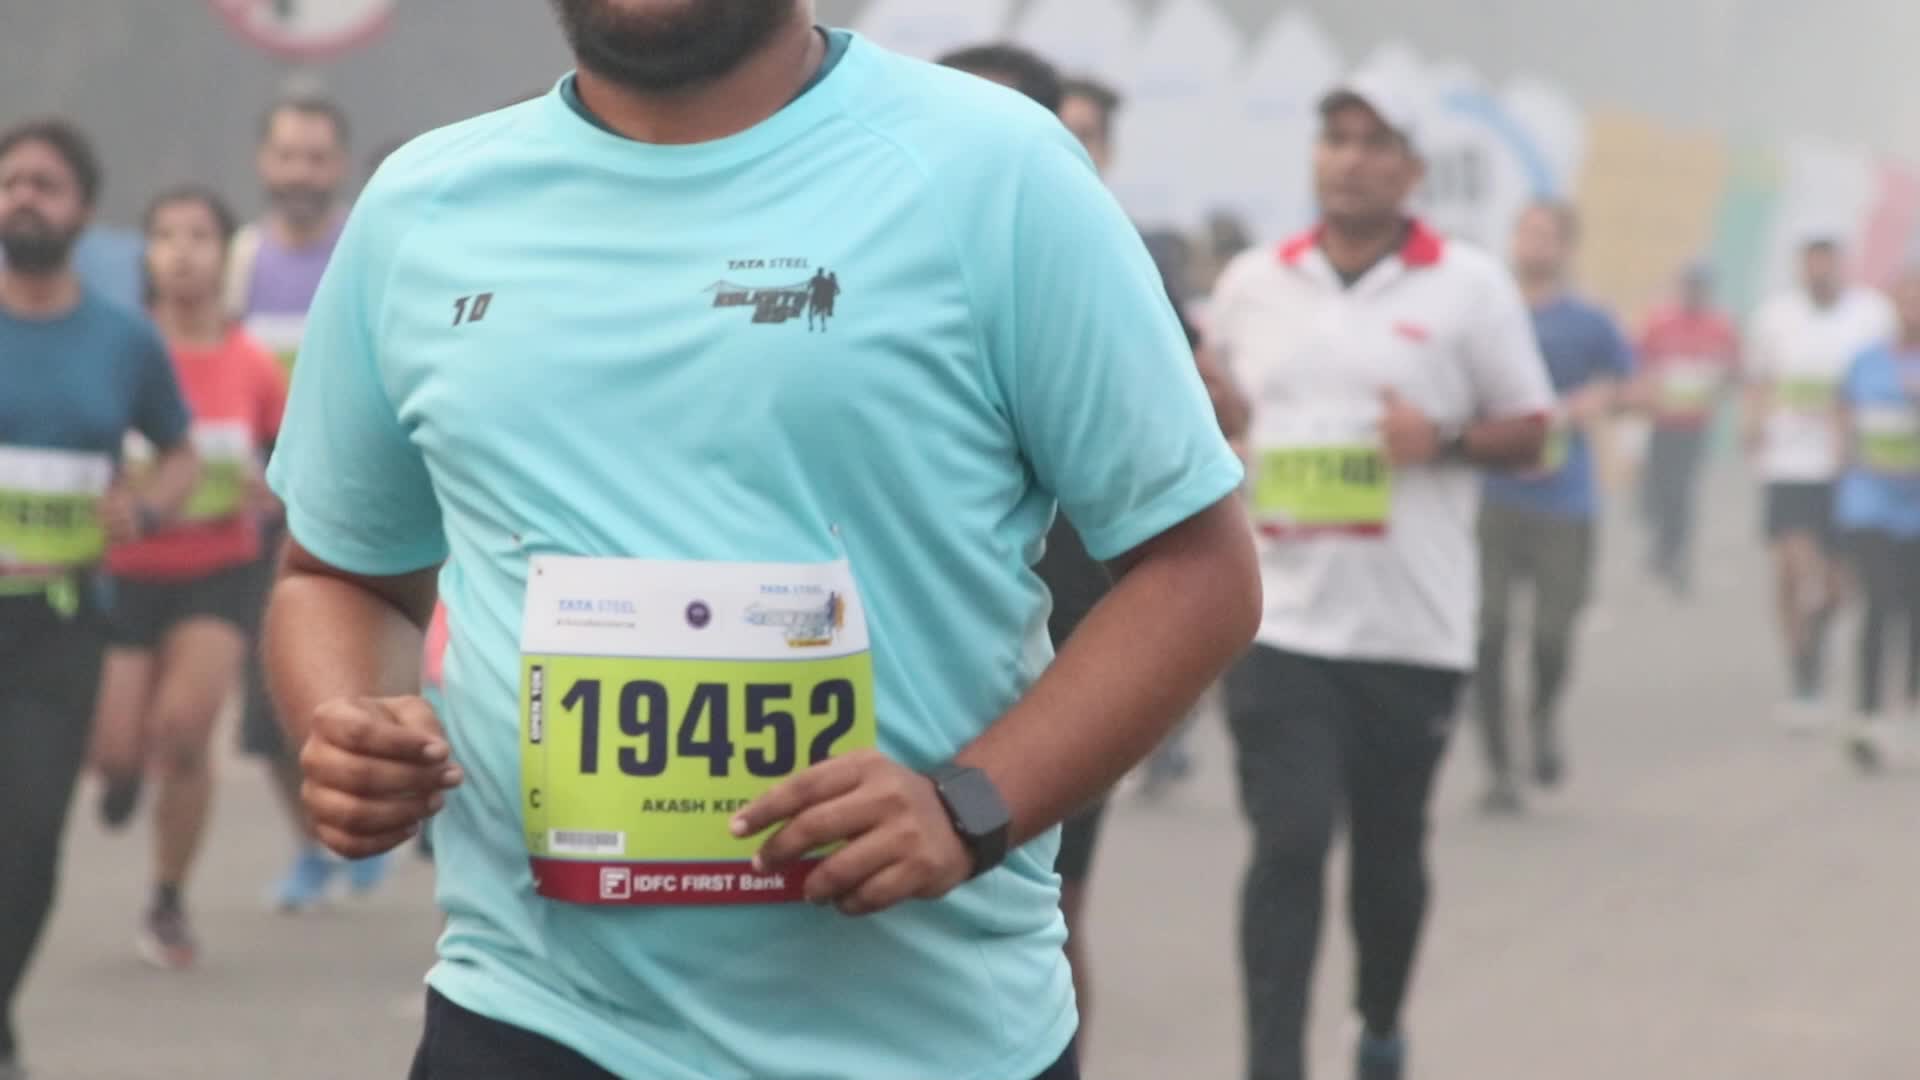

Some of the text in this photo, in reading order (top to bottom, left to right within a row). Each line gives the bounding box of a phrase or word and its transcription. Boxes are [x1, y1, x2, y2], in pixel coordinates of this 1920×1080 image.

[728, 257, 808, 270] TATA STEEL
[453, 293, 494, 326] 10
[559, 600, 637, 613] TATA STEEL
[561, 678, 856, 778] 19452
[530, 788, 541, 809] C
[641, 798, 706, 812] AKASH
[634, 874, 784, 891] IDFC FIRST Bank
